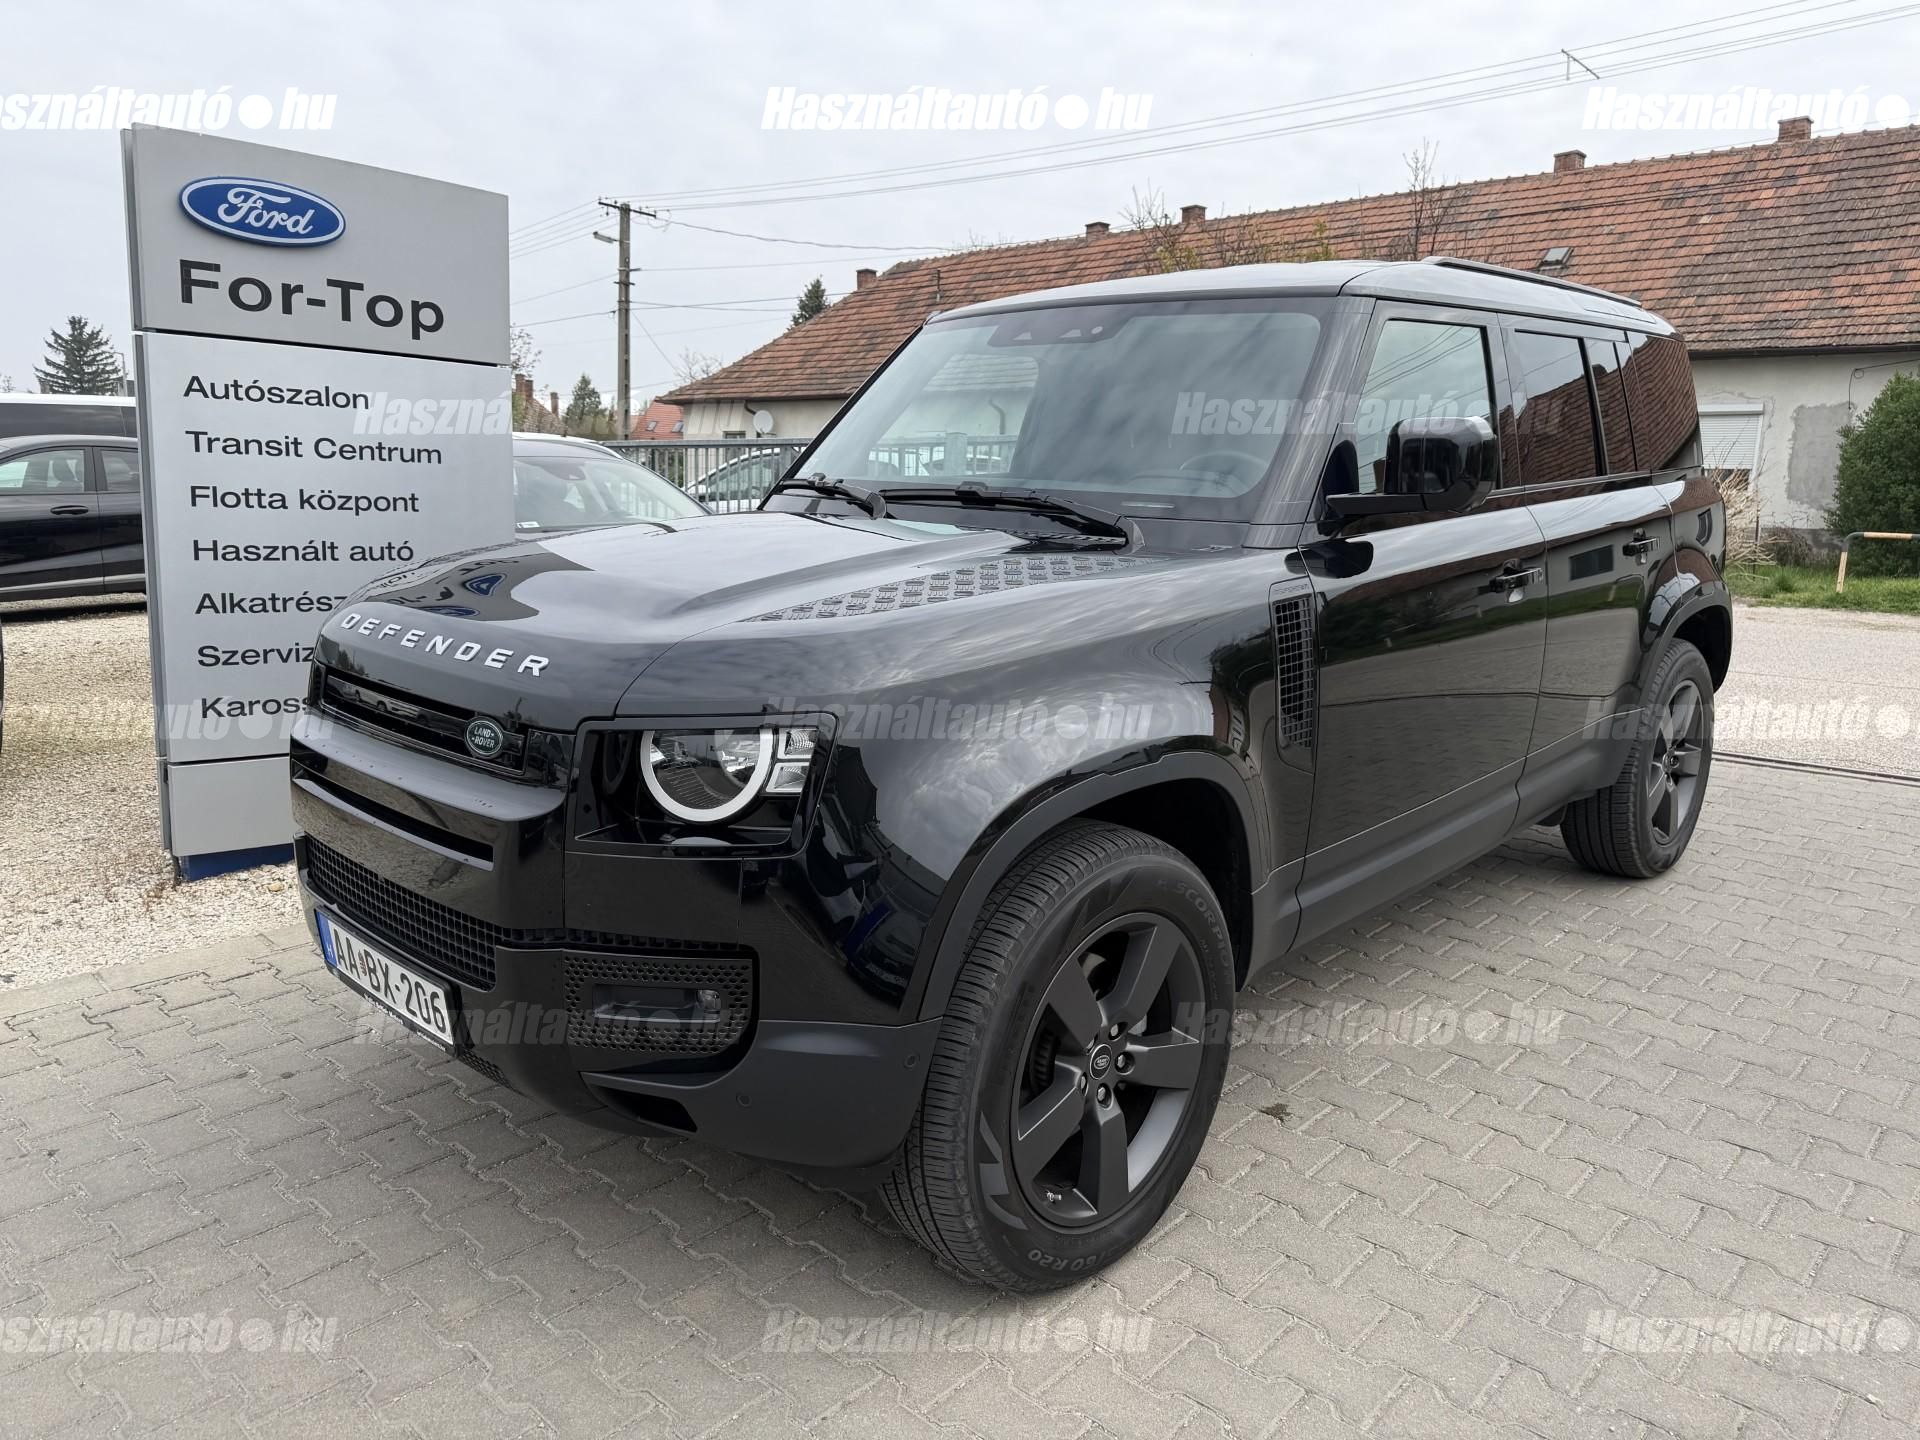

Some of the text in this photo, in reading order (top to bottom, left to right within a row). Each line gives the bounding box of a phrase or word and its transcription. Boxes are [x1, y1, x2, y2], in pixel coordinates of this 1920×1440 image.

[217, 187, 316, 235] Ford
[180, 259, 445, 341] For-Top
[183, 375, 370, 410] Autószalon
[185, 430, 443, 465] Transit Centrum
[190, 485, 420, 516] Flotta központ
[193, 540, 415, 562] Használt autó
[197, 642, 315, 668] Szerviz
[341, 612, 550, 677] DEFENDER
[474, 726, 491, 738] LAND
[474, 736, 495, 748] ROVER
